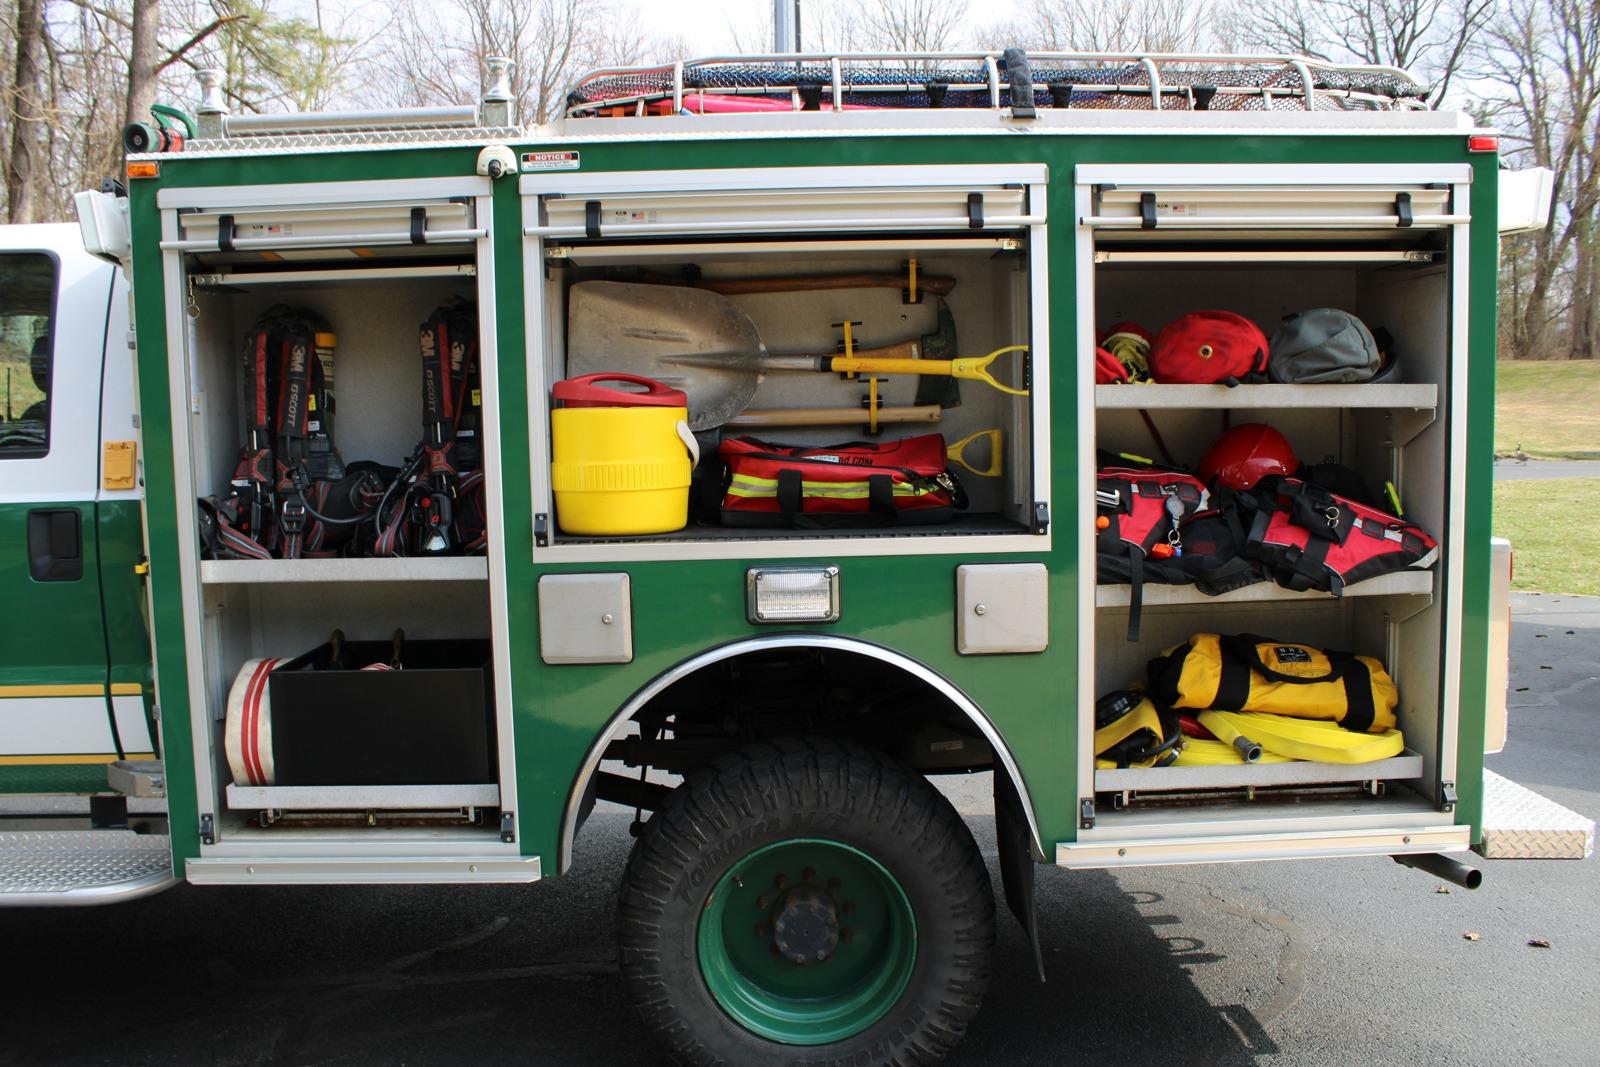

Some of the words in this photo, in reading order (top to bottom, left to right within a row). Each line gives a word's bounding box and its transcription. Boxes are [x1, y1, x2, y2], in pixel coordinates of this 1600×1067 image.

[420, 329, 435, 356] 3M
[450, 341, 465, 371] 3M
[290, 344, 306, 372] 3M
